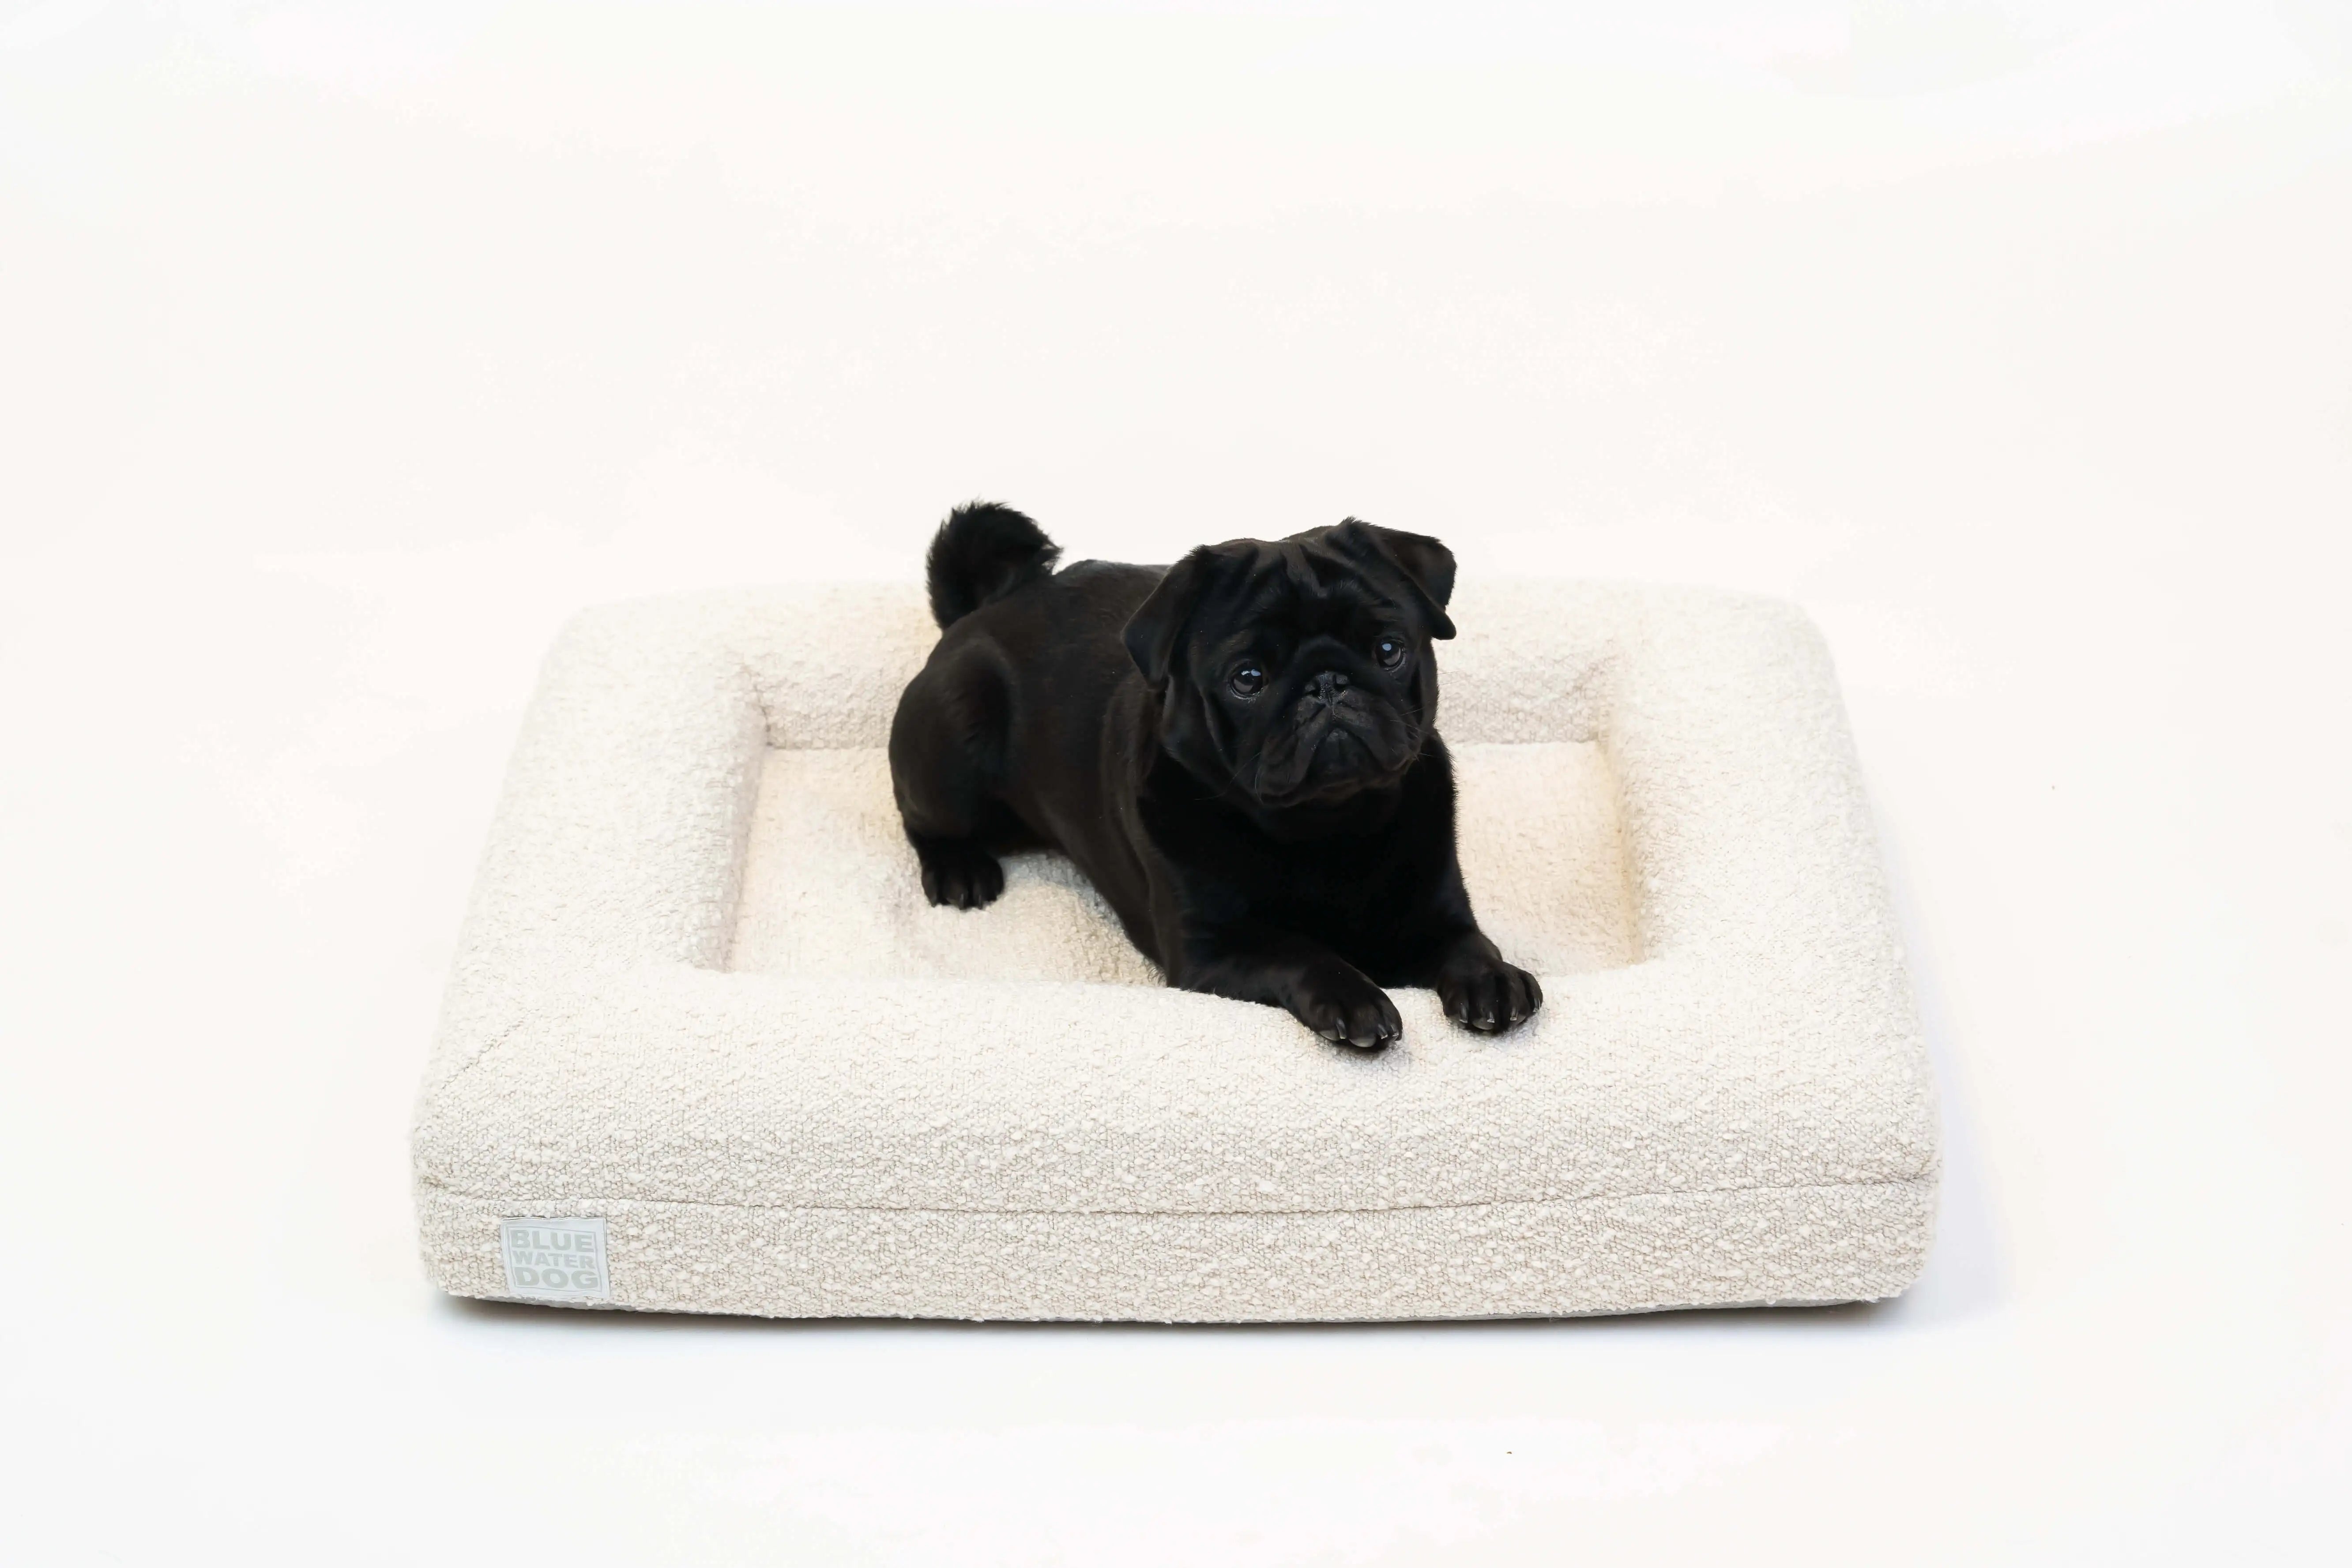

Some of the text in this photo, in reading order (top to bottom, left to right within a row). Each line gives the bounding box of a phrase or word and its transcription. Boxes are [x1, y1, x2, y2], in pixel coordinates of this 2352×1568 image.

[511, 1230, 594, 1252] BLUE
[512, 1251, 595, 1269] WATER
[514, 1267, 598, 1289] DOG
